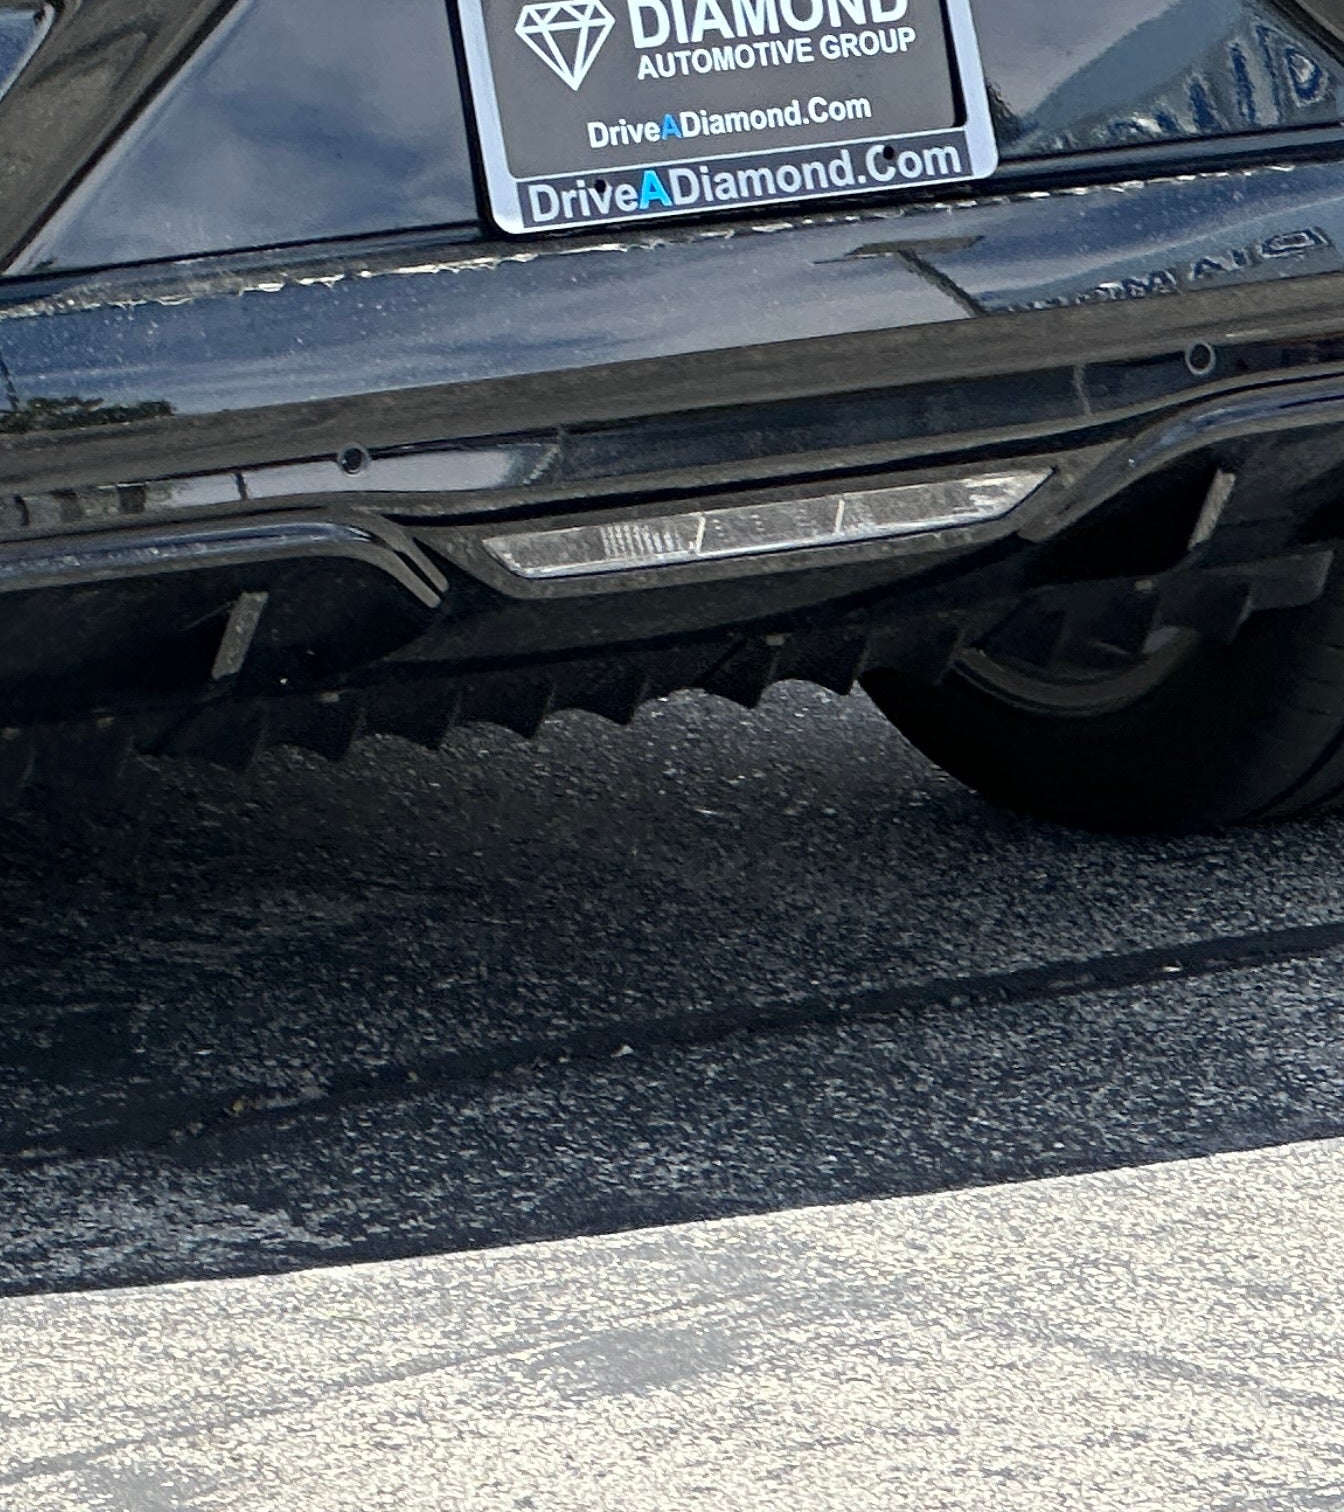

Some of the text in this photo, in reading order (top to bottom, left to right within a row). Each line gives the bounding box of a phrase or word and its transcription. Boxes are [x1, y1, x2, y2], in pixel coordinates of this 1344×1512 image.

[637, 26, 917, 81] AUTOMOTIVE GROUP
[587, 96, 872, 149] DriveADiamond.Com
[529, 143, 962, 225] DriveADiamond.Com
